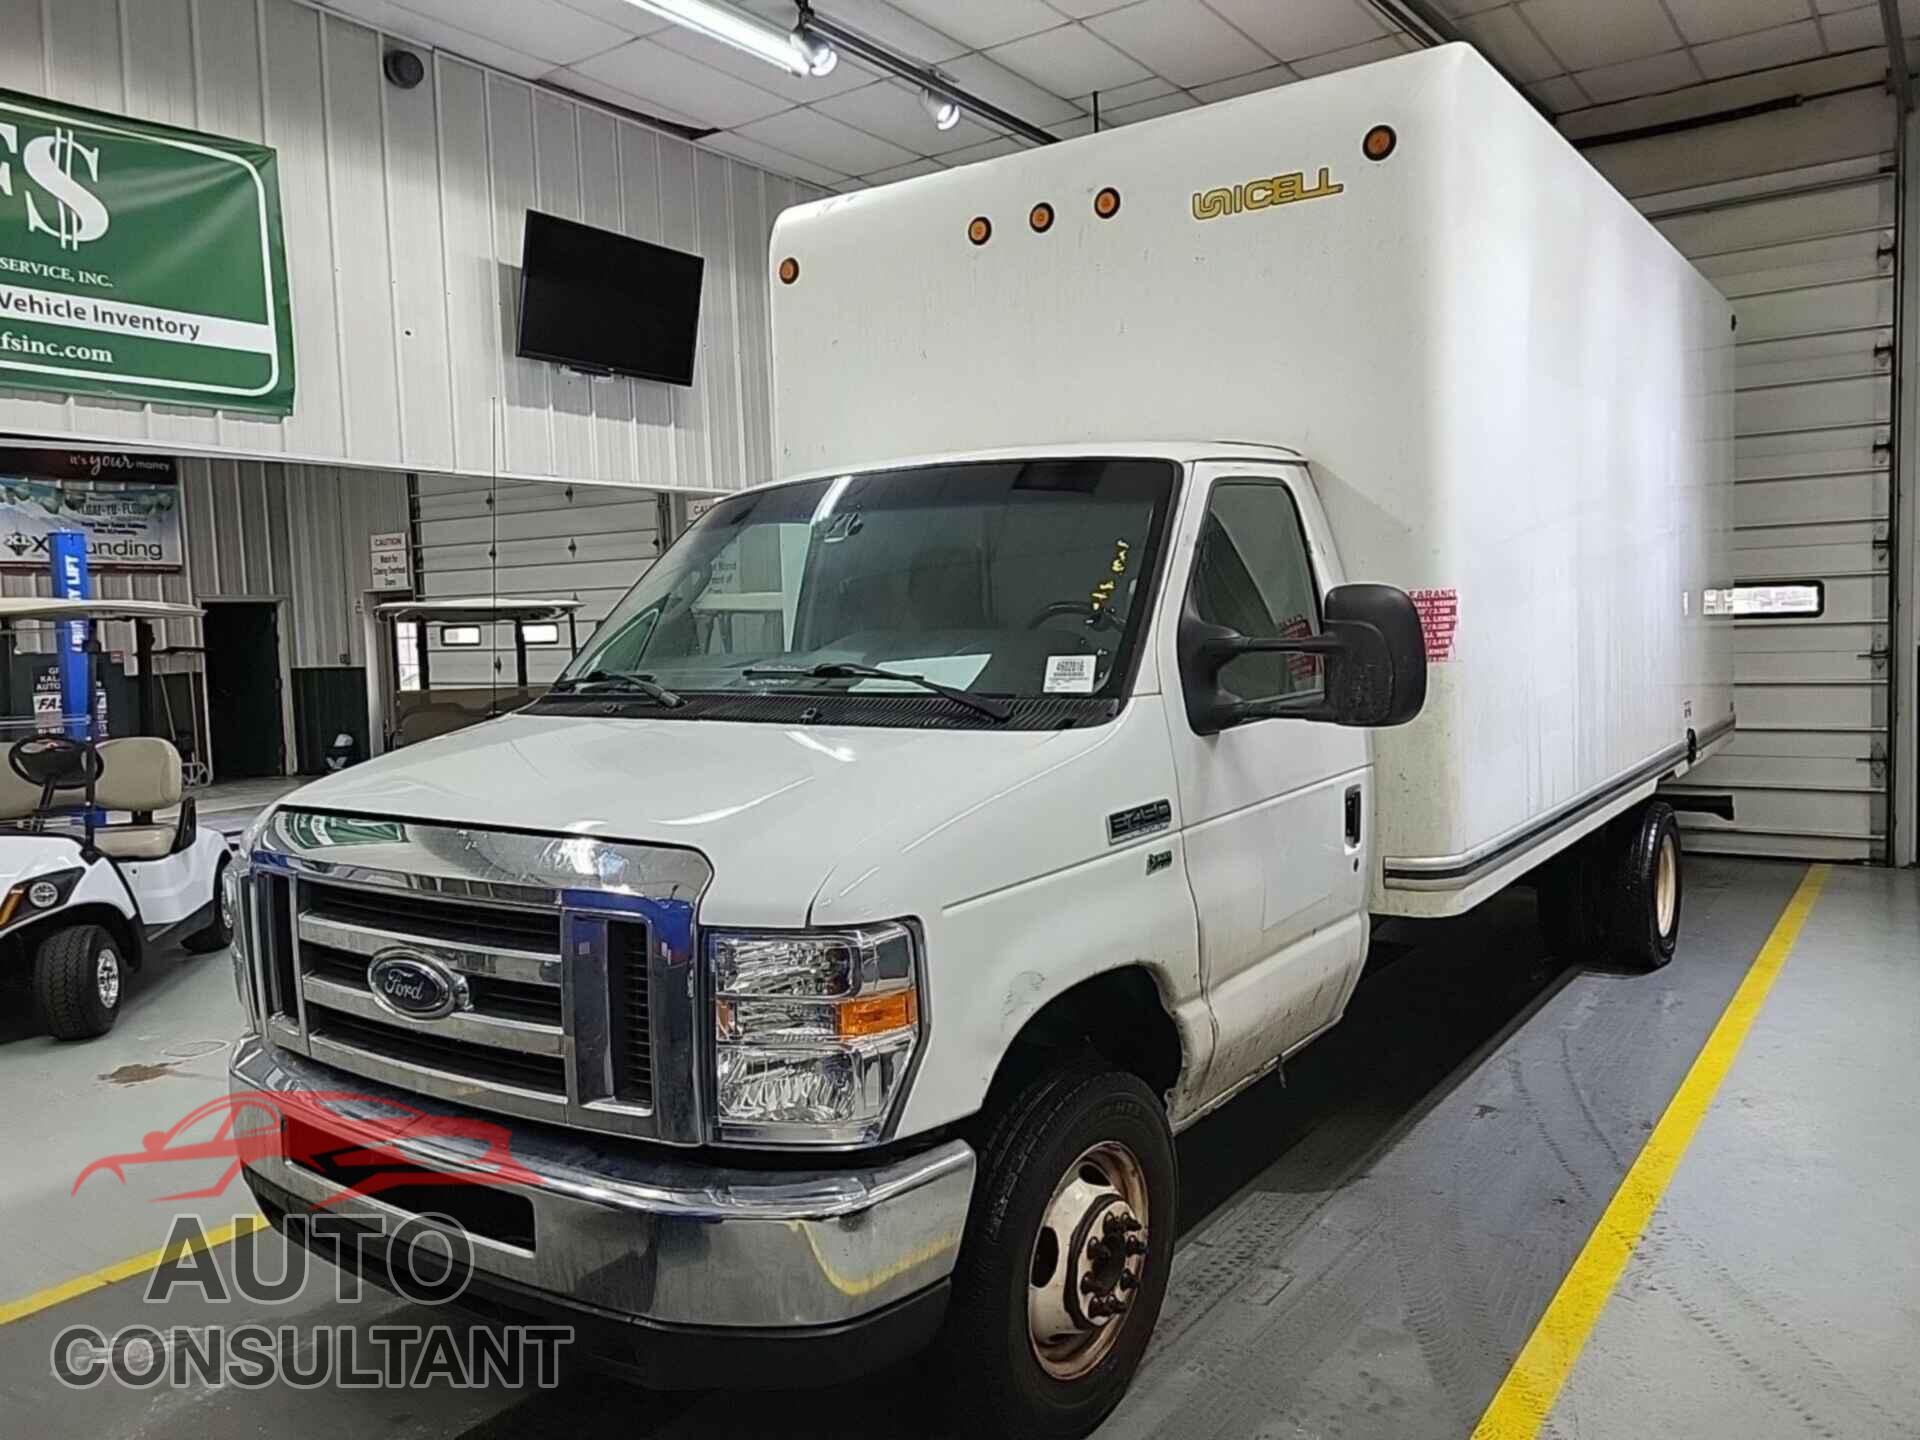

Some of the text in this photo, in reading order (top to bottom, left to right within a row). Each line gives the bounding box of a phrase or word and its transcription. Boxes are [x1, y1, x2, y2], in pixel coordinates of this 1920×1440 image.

[0, 256, 113, 287] SERVICE, INC.
[0, 290, 200, 341] Vehicle Inventory
[89, 454, 135, 476] your
[385, 969, 424, 1000] Ford
